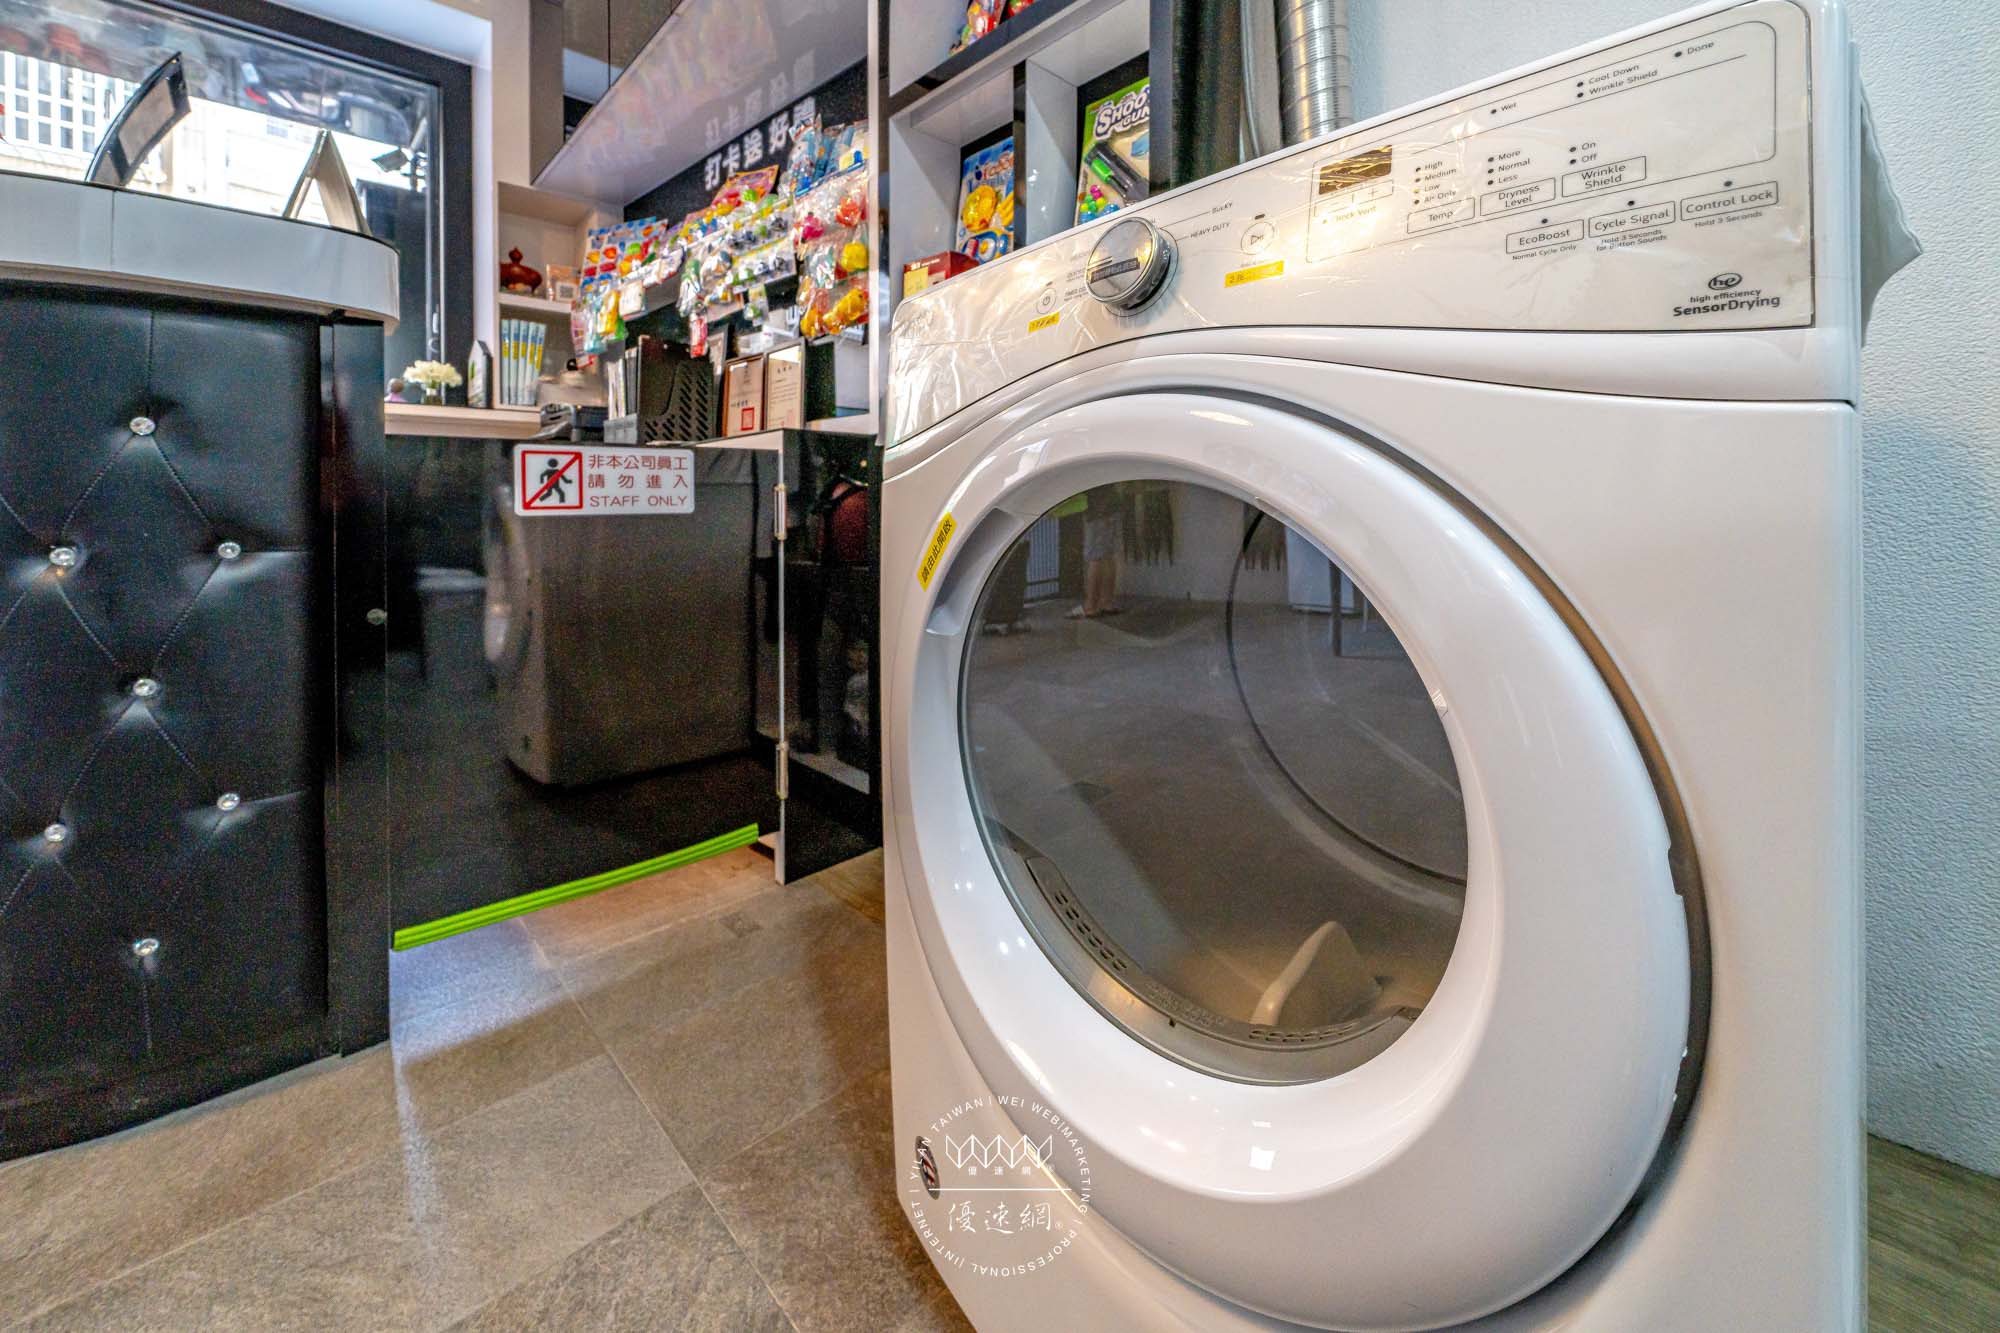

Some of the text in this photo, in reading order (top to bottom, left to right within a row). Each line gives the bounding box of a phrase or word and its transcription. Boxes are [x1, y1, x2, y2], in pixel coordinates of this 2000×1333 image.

[1687, 42, 1714, 55] Done
[1588, 65, 1639, 85] Cool Down
[1589, 70, 1658, 96] Wrinkle Shield
[1096, 87, 1149, 135] SHOO
[1501, 103, 1517, 112] Wet
[1581, 141, 1597, 151] On
[1498, 150, 1521, 161] More
[1581, 153, 1597, 164] Off
[1425, 160, 1443, 171] High
[1498, 158, 1530, 173] Normal
[1581, 163, 1626, 181] Wrinkle
[1425, 167, 1456, 181] Medium
[1498, 173, 1518, 184] Less
[1584, 173, 1622, 190] Shield
[1498, 184, 1540, 202] Dryness
[1505, 195, 1533, 208] Level
[1686, 189, 1773, 214] Control Lock
[1428, 210, 1454, 223] Temp
[1594, 208, 1669, 232] Cycle Signal
[1694, 210, 1763, 228] Hold 3 Seconds
[1519, 228, 1571, 246] EcoBoost
[1628, 229, 1662, 240] Seconds
[1637, 234, 1667, 245] Sounds
[1512, 251, 1537, 261] Normal
[1559, 244, 1577, 254] Only
[1690, 288, 1762, 304] high efficiency
[1673, 295, 1780, 317] SensorDrying
[588, 454, 688, 470] 非本公司員工
[588, 474, 688, 489] 請勿進入
[590, 495, 688, 507] STAFF ONLY
